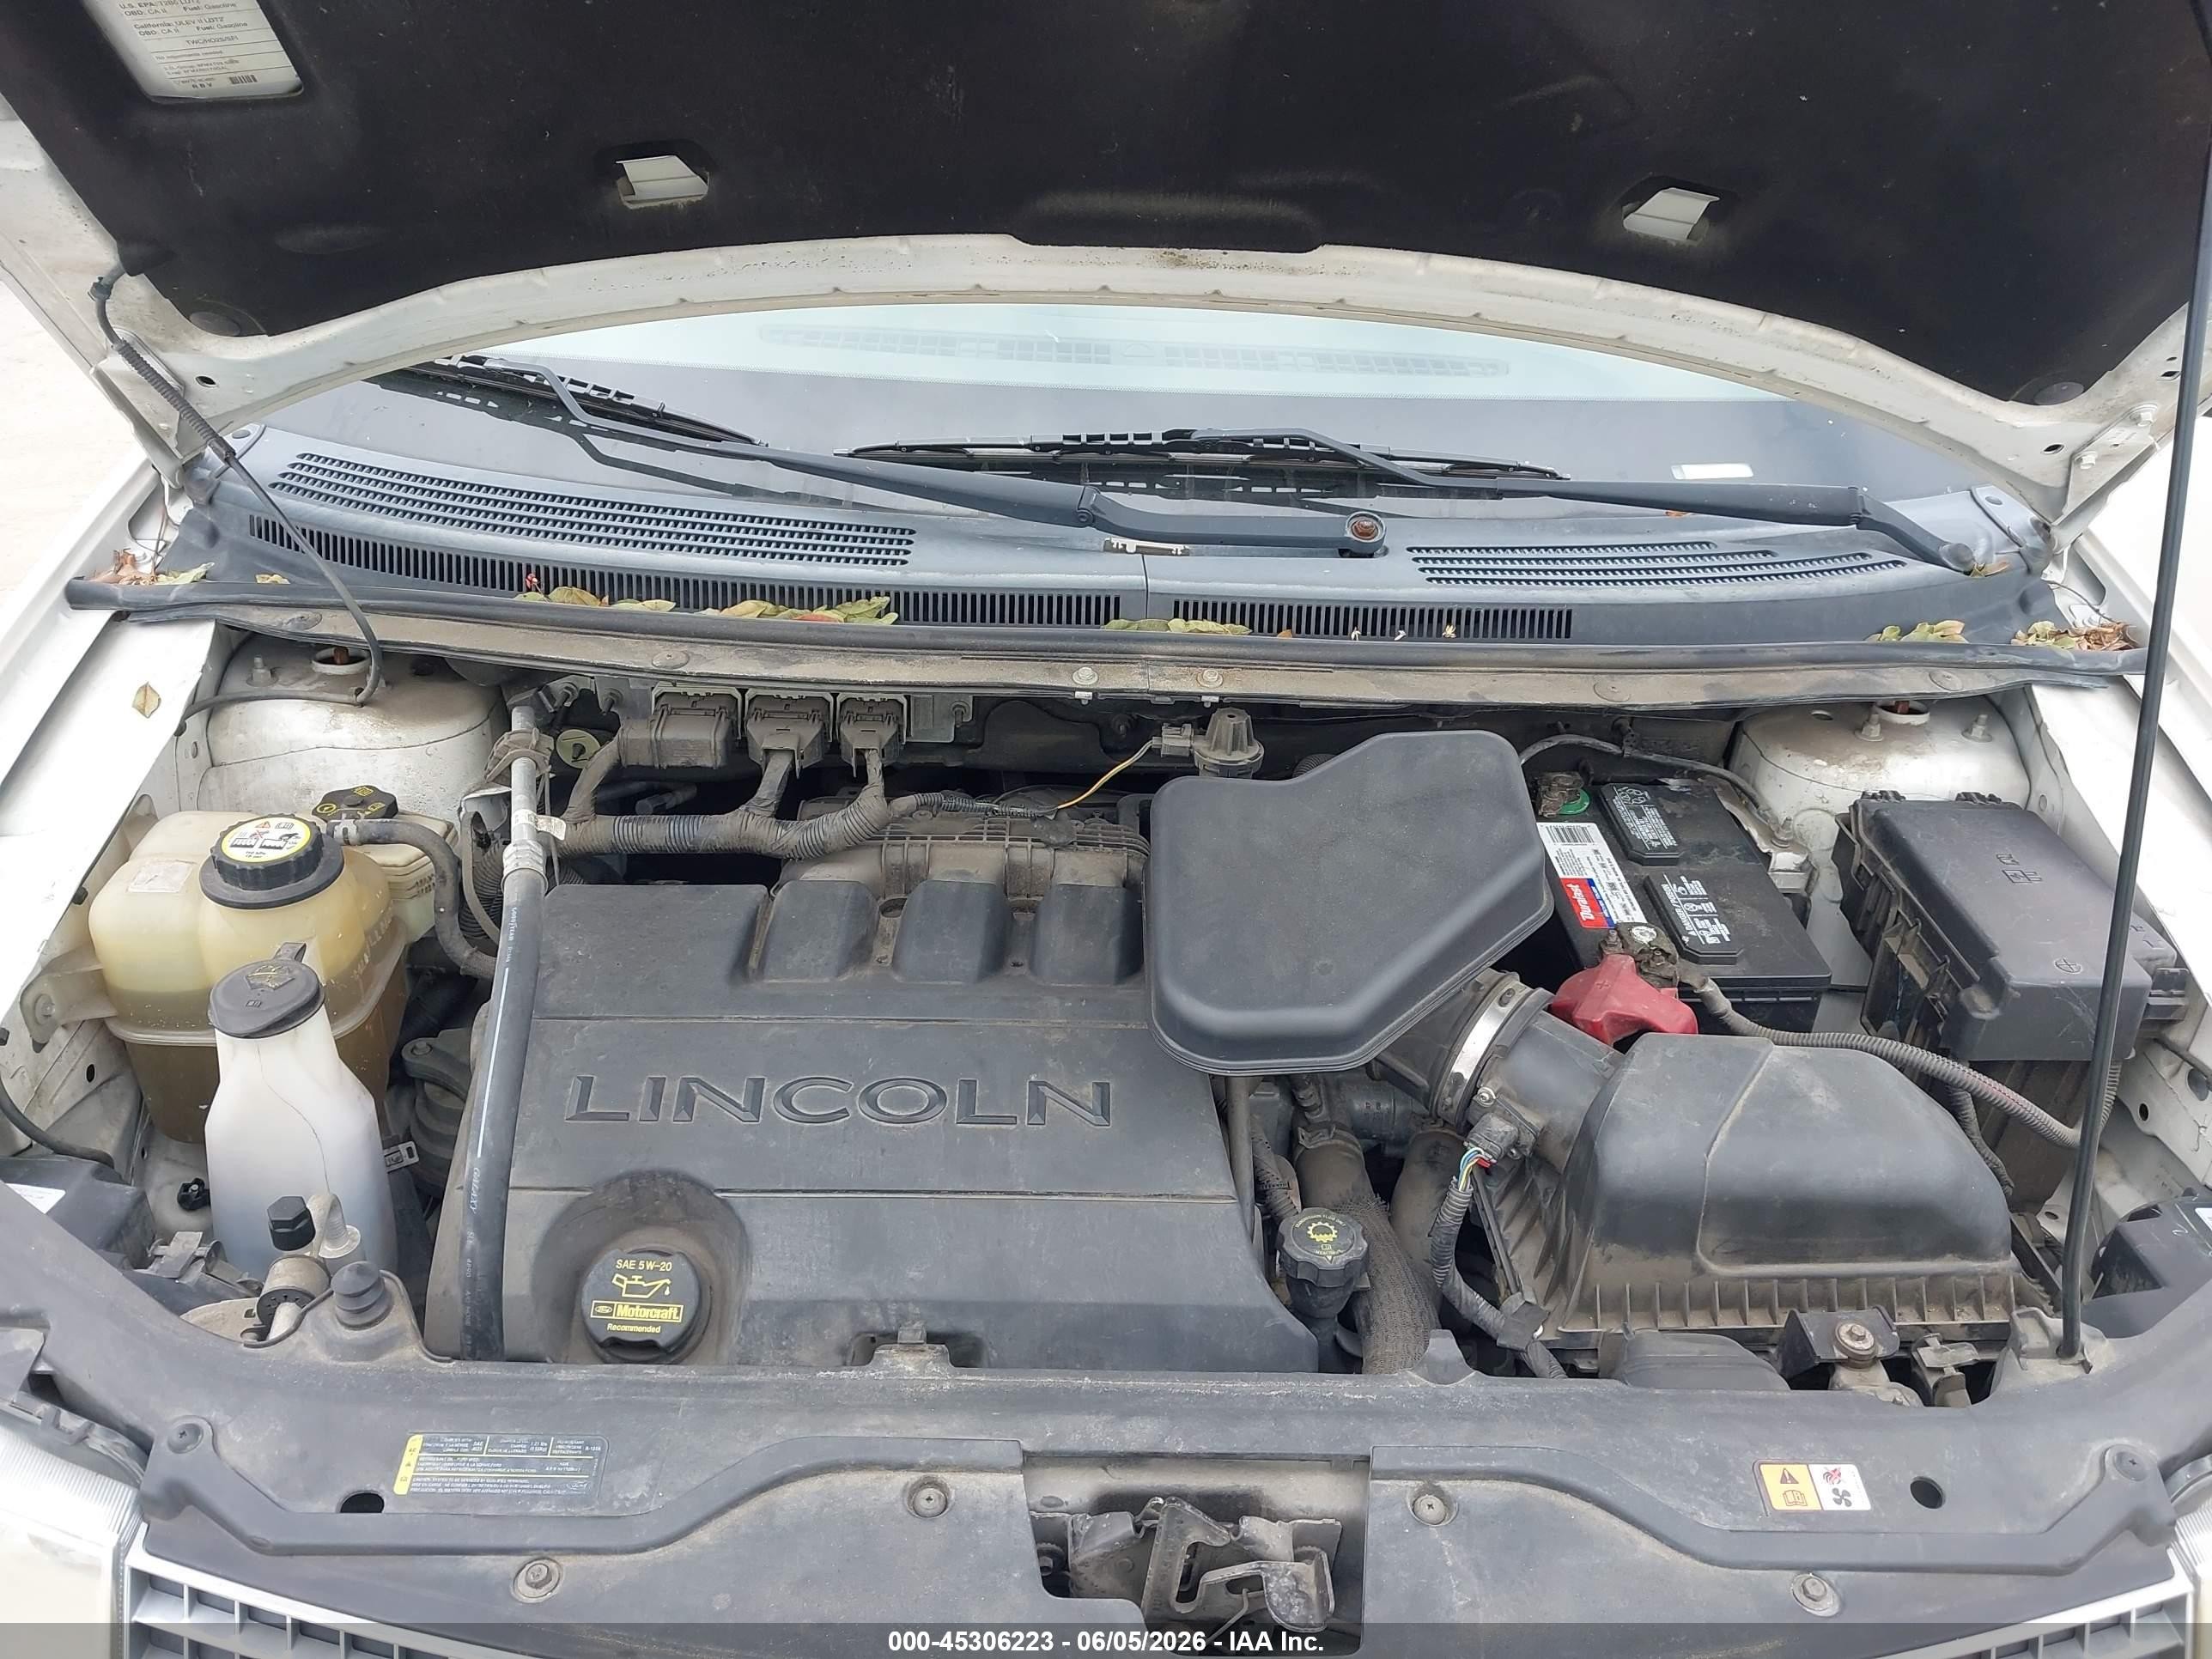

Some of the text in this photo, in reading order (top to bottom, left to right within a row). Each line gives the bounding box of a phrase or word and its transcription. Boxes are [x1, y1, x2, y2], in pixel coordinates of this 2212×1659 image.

[1566, 884, 1595, 921] Duralast
[565, 1075, 1110, 1126] LINCOLN
[470, 1167, 481, 1214] GALAXY
[616, 1259, 672, 1272] SAE 5W-20
[616, 1304, 680, 1320] Motorcraft
[607, 1323, 661, 1334] Recommended
